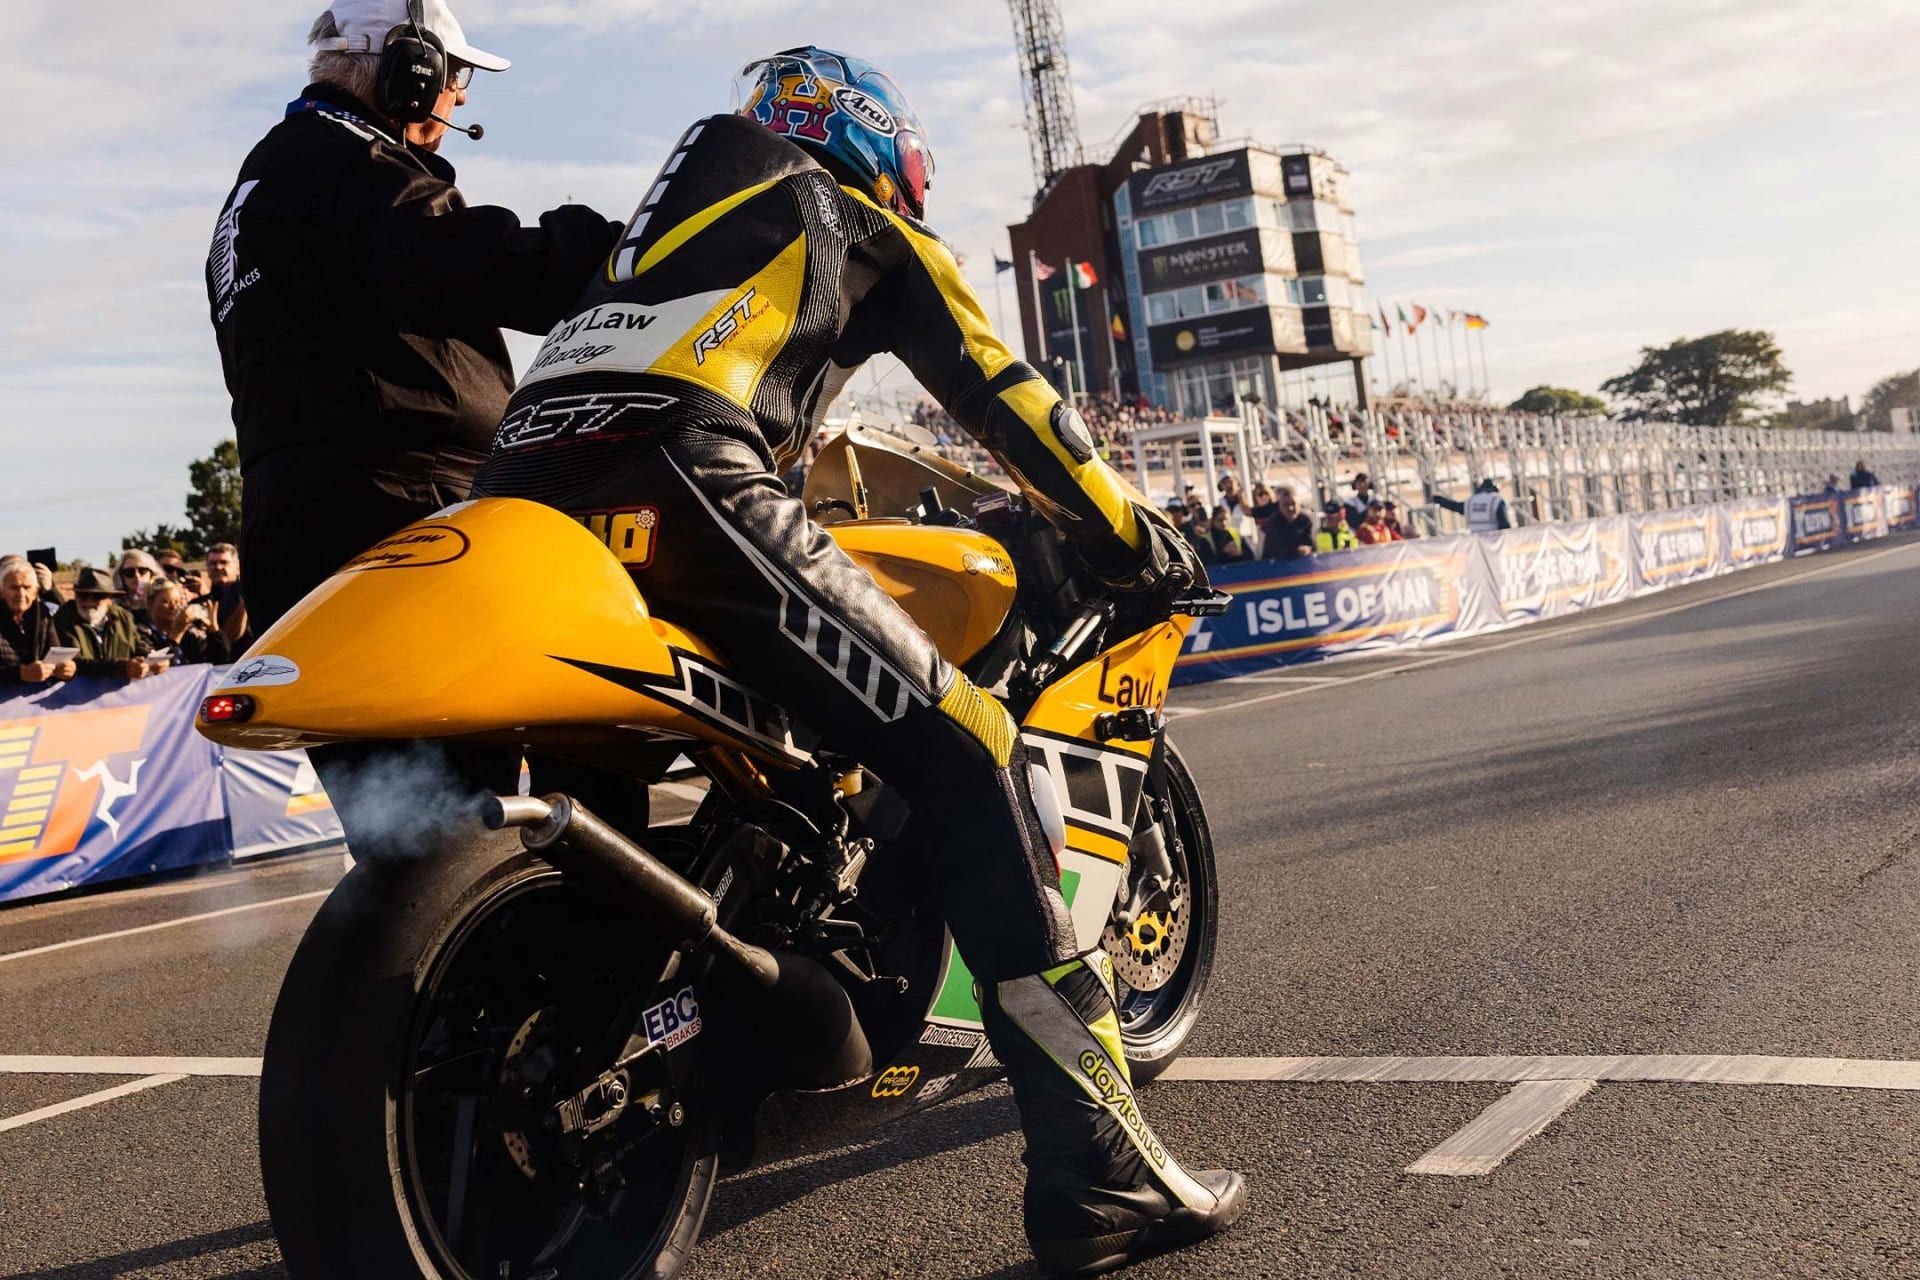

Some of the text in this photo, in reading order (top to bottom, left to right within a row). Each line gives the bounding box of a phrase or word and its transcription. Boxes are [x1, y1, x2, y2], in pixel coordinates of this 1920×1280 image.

[840, 96, 890, 127] Arai
[1143, 158, 1236, 196] RST
[1169, 241, 1249, 267] MONSTER
[232, 267, 261, 295] RACES
[693, 286, 756, 367] RST
[1245, 575, 1432, 636] ISLE OF MAN
[644, 989, 698, 1043] EBC
[667, 1018, 702, 1049] BRAKES
[919, 1024, 985, 1049] BRIDGESTONE
[915, 1073, 957, 1098] EBC
[1079, 1049, 1167, 1170] daytona
